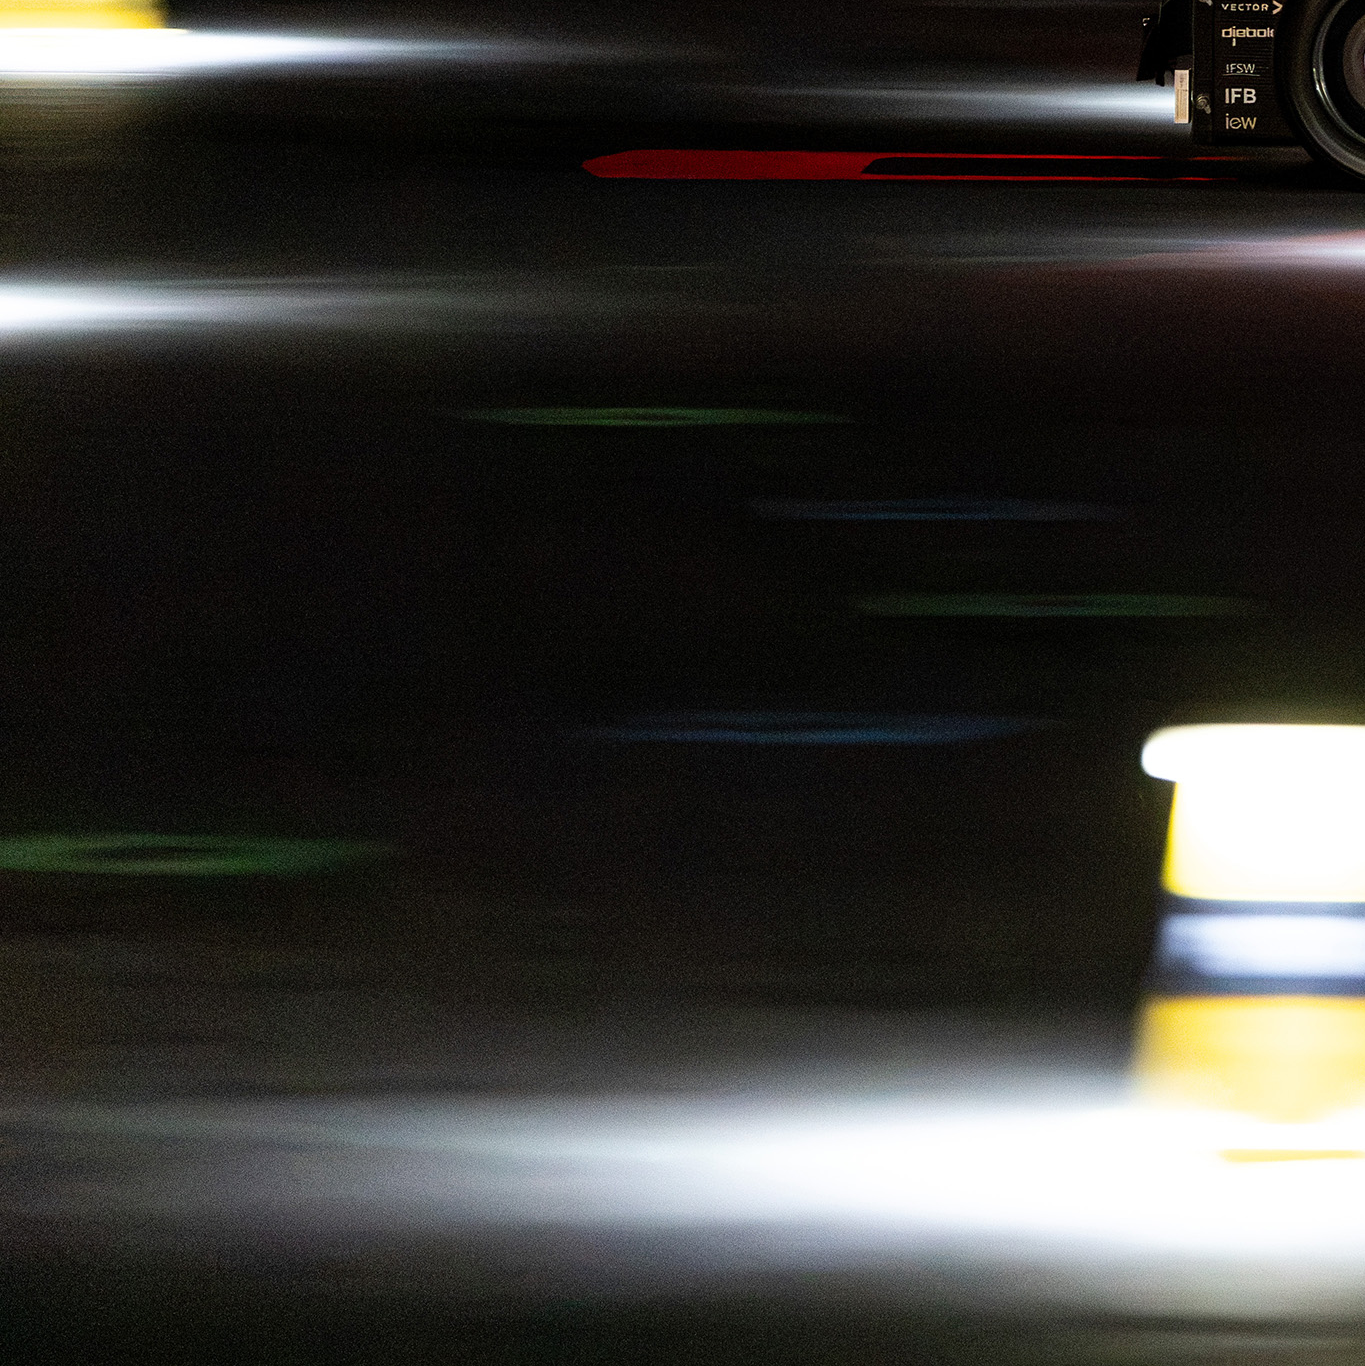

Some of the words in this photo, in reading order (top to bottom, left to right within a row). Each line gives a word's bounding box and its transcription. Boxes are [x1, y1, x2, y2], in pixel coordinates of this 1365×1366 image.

[1221, 3, 1269, 12] VECTOR
[1226, 64, 1256, 73] IFSW
[1224, 88, 1257, 104] IFB
